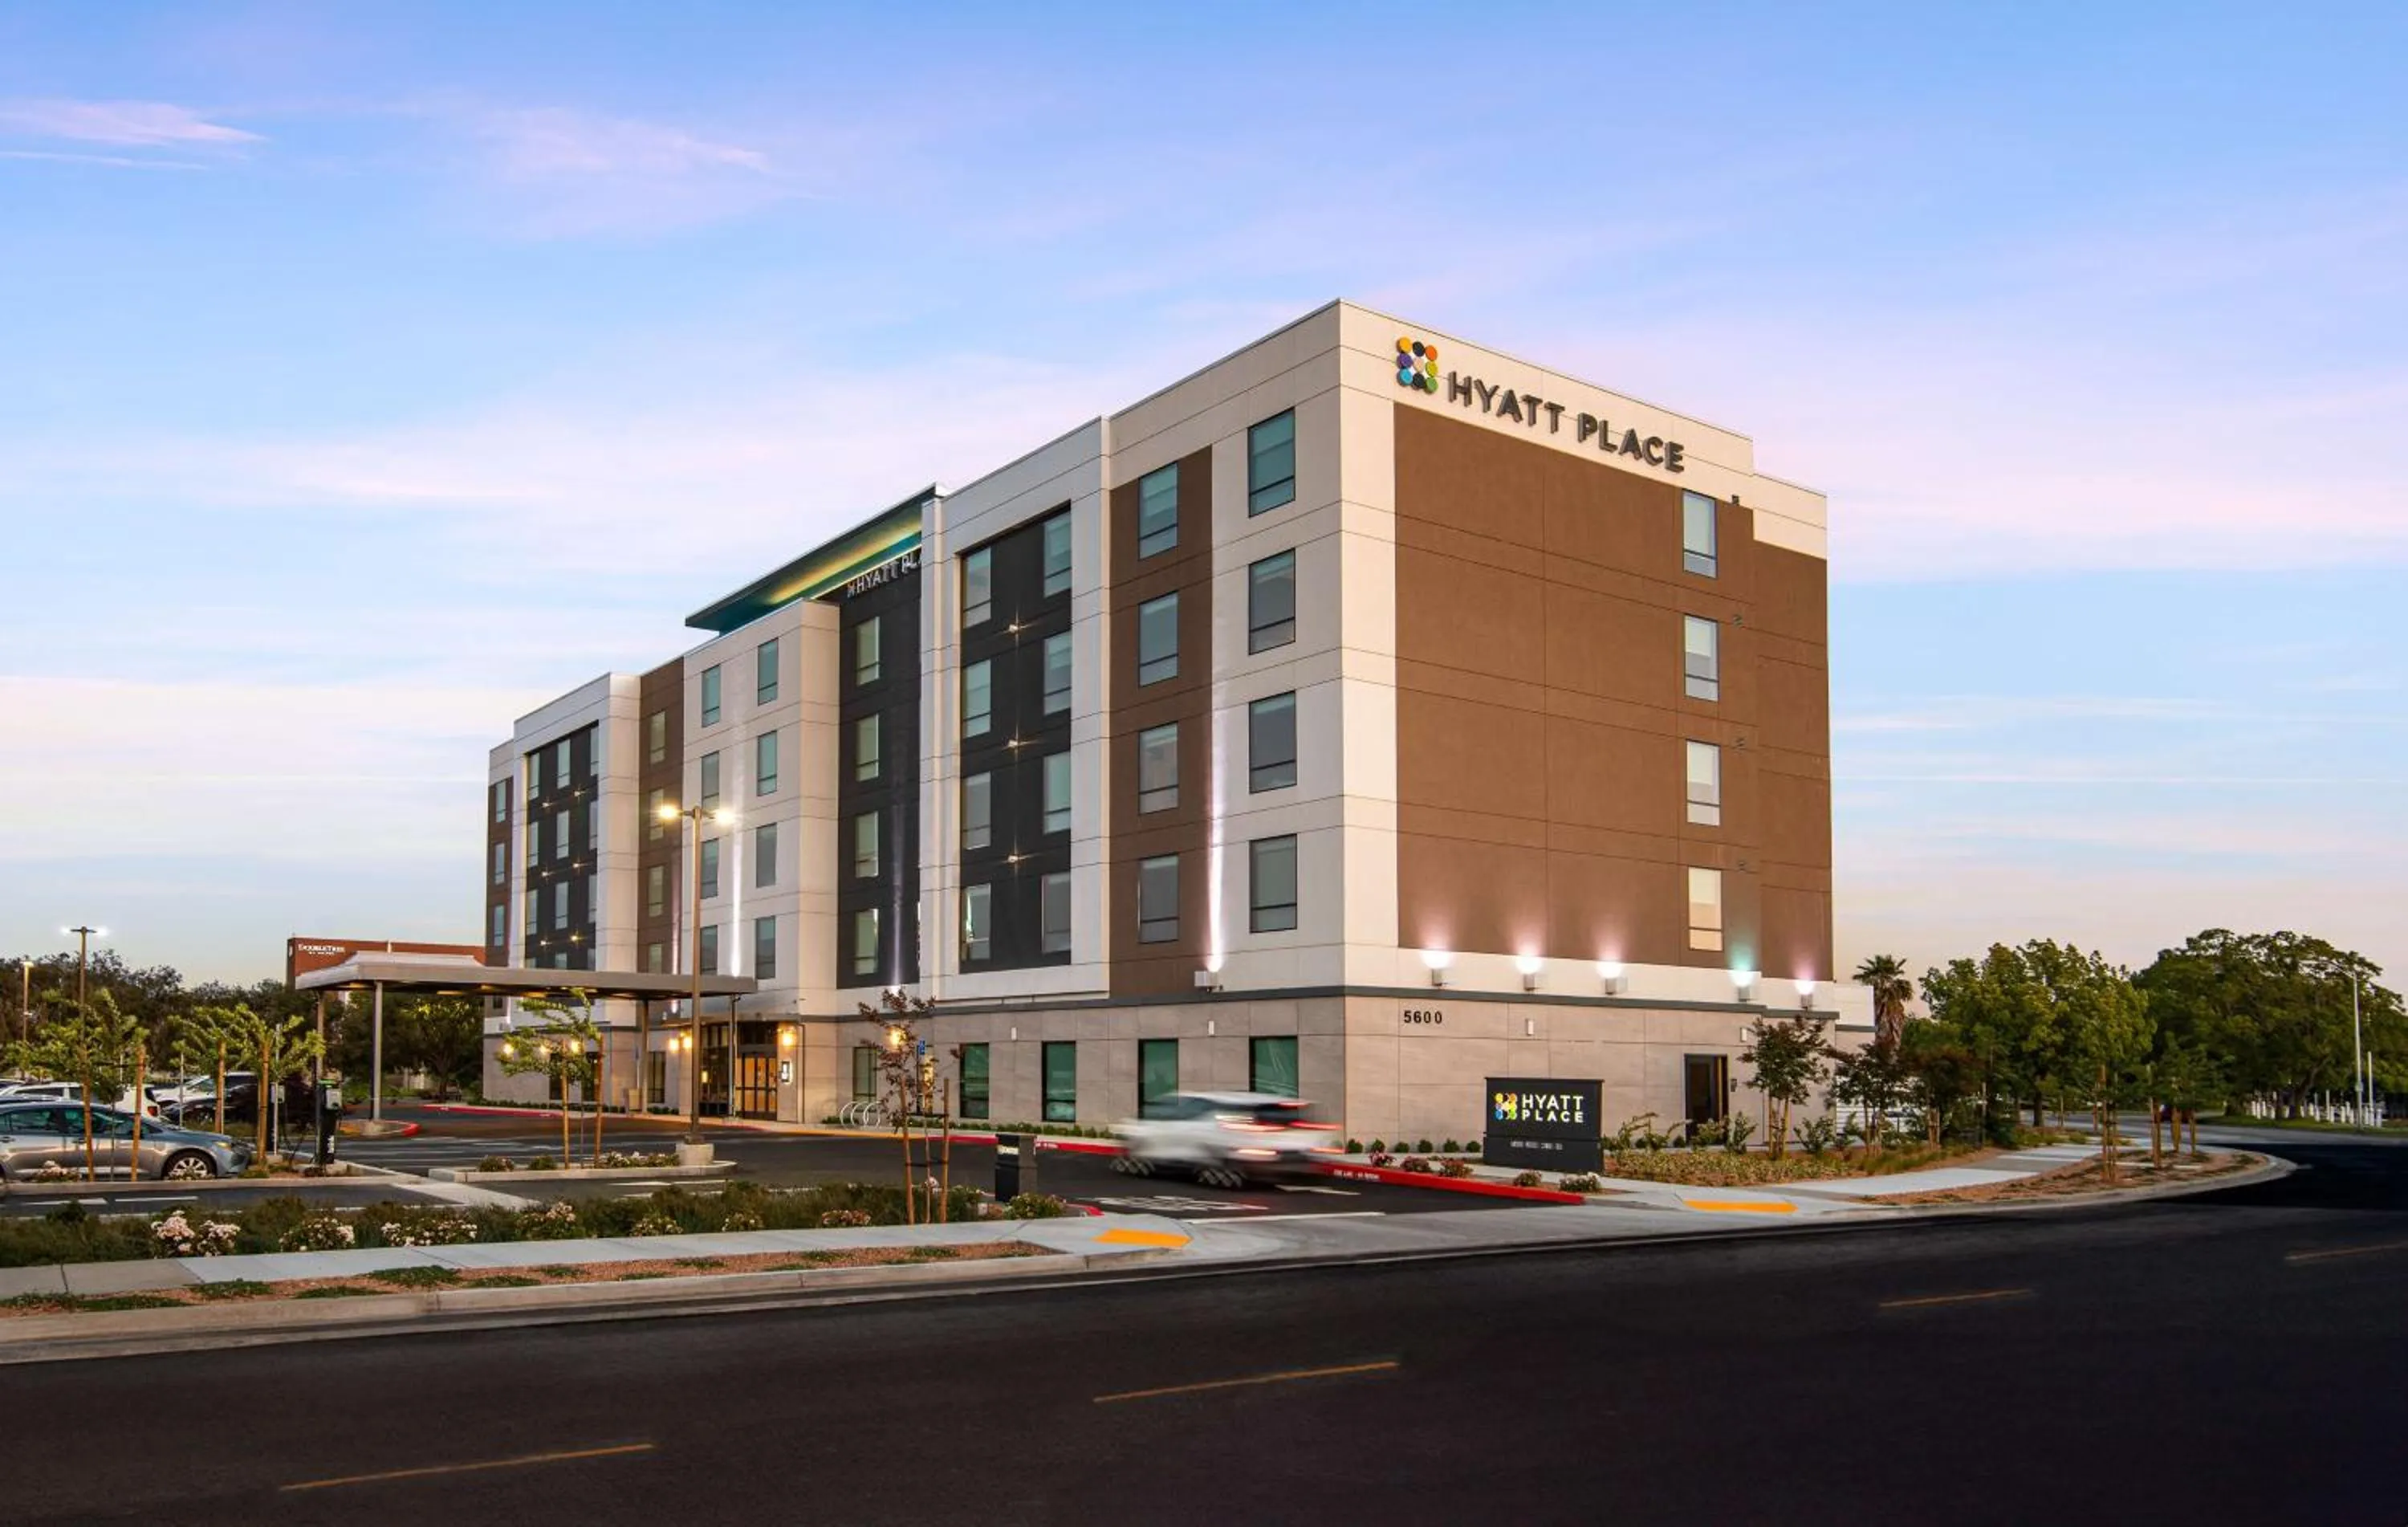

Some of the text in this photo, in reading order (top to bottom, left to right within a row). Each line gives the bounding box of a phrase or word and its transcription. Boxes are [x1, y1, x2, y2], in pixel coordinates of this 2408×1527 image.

[1448, 371, 1685, 473] HYATT PLACE
[856, 561, 899, 593] HYATT
[1404, 1010, 1442, 1024] 5600
[1522, 1093, 1584, 1110] HYATT
[1522, 1109, 1584, 1123] PLACE
